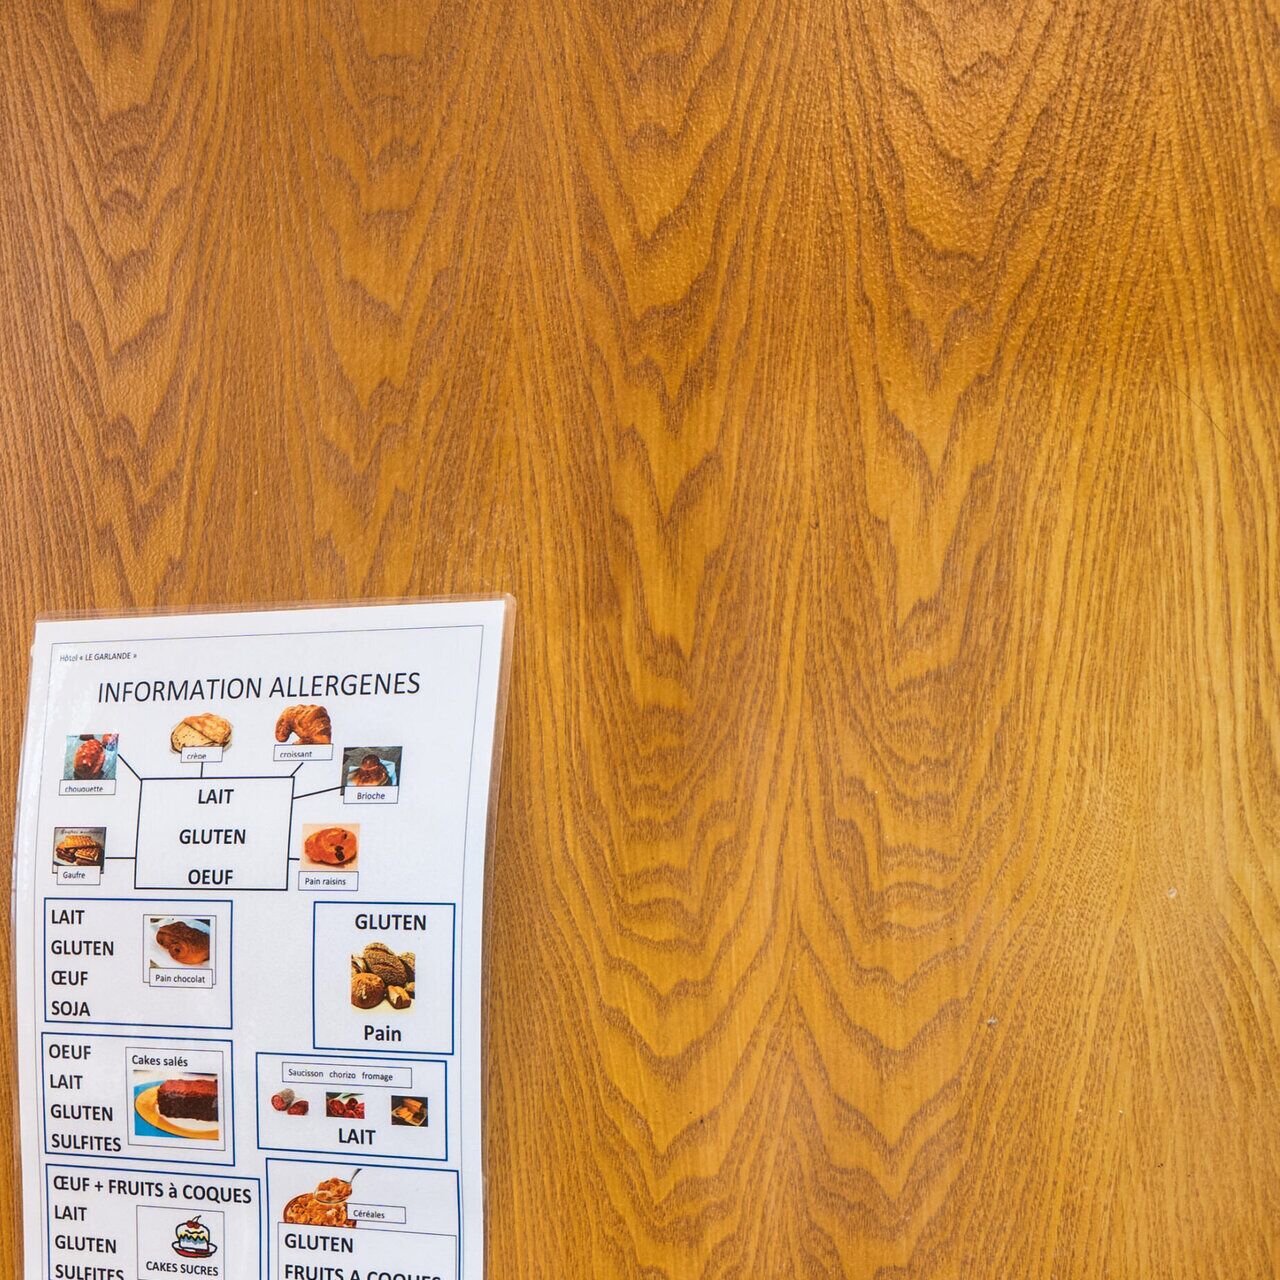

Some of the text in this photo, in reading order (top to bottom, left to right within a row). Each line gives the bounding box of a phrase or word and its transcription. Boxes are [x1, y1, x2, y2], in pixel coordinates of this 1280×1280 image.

[84, 653, 93, 662] LE
[93, 651, 131, 661] GARLANDE
[98, 671, 420, 703] INFORMATION ALLERGENES
[279, 750, 313, 759] croissant
[197, 788, 235, 805] LAIT
[356, 791, 386, 800] Brioche
[179, 828, 246, 845] GLUTEN
[62, 870, 86, 879] Gaufre
[187, 869, 234, 886] OEUF
[304, 877, 347, 886] Pain raisins
[51, 909, 86, 925] LAIT
[354, 913, 427, 931] GLUTEN
[50, 939, 114, 957] GLUTEN
[51, 970, 89, 986] ŒUF
[155, 973, 206, 984] Pain chocolat
[51, 1000, 91, 1017] SOJA
[364, 1024, 402, 1042] Pain
[48, 1043, 92, 1060] OEUF
[131, 1054, 189, 1068] Cakes salés
[49, 1073, 84, 1090] LAIT
[288, 1068, 394, 1083] Saucisson chorizo fromage
[50, 1103, 113, 1122] GLUTEN
[50, 1133, 122, 1153] SULFITES
[338, 1127, 377, 1146] LAIT
[53, 1175, 252, 1204] ŒUF + FRUITS à COQUES
[54, 1204, 88, 1222] LAIT
[352, 1209, 386, 1220] Céréales
[54, 1234, 117, 1254] GLUTEN
[284, 1233, 354, 1254] GLUTEN
[145, 1260, 219, 1277] CAKES SUCRES
